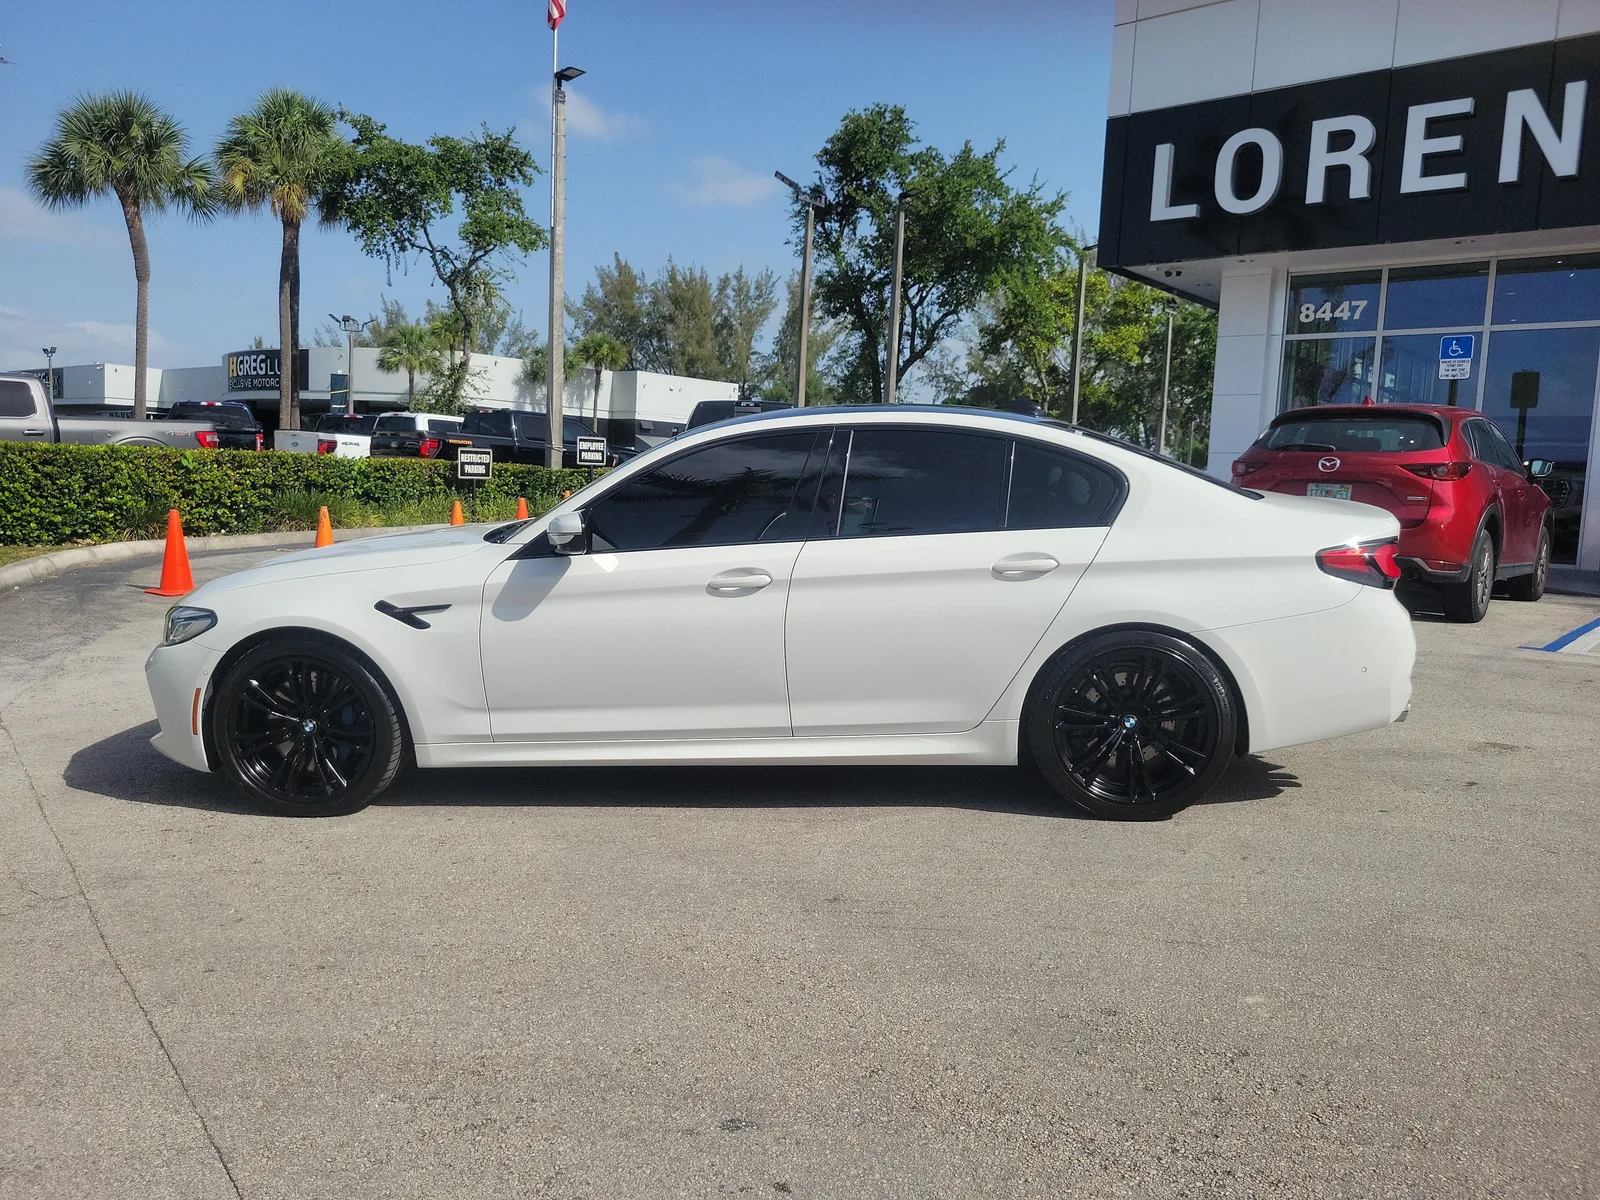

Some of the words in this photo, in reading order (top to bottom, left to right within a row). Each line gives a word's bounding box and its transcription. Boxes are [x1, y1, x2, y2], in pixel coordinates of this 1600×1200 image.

[1150, 80, 1588, 222] LOREN
[1299, 300, 1368, 323] 8447
[229, 354, 266, 378] HGREG
[253, 378, 280, 388] MOTORC
[580, 441, 605, 451] EMPLOYEE
[460, 453, 490, 463] RESTRICTED
[581, 451, 602, 461] PARKING
[464, 464, 486, 474] PARKING
